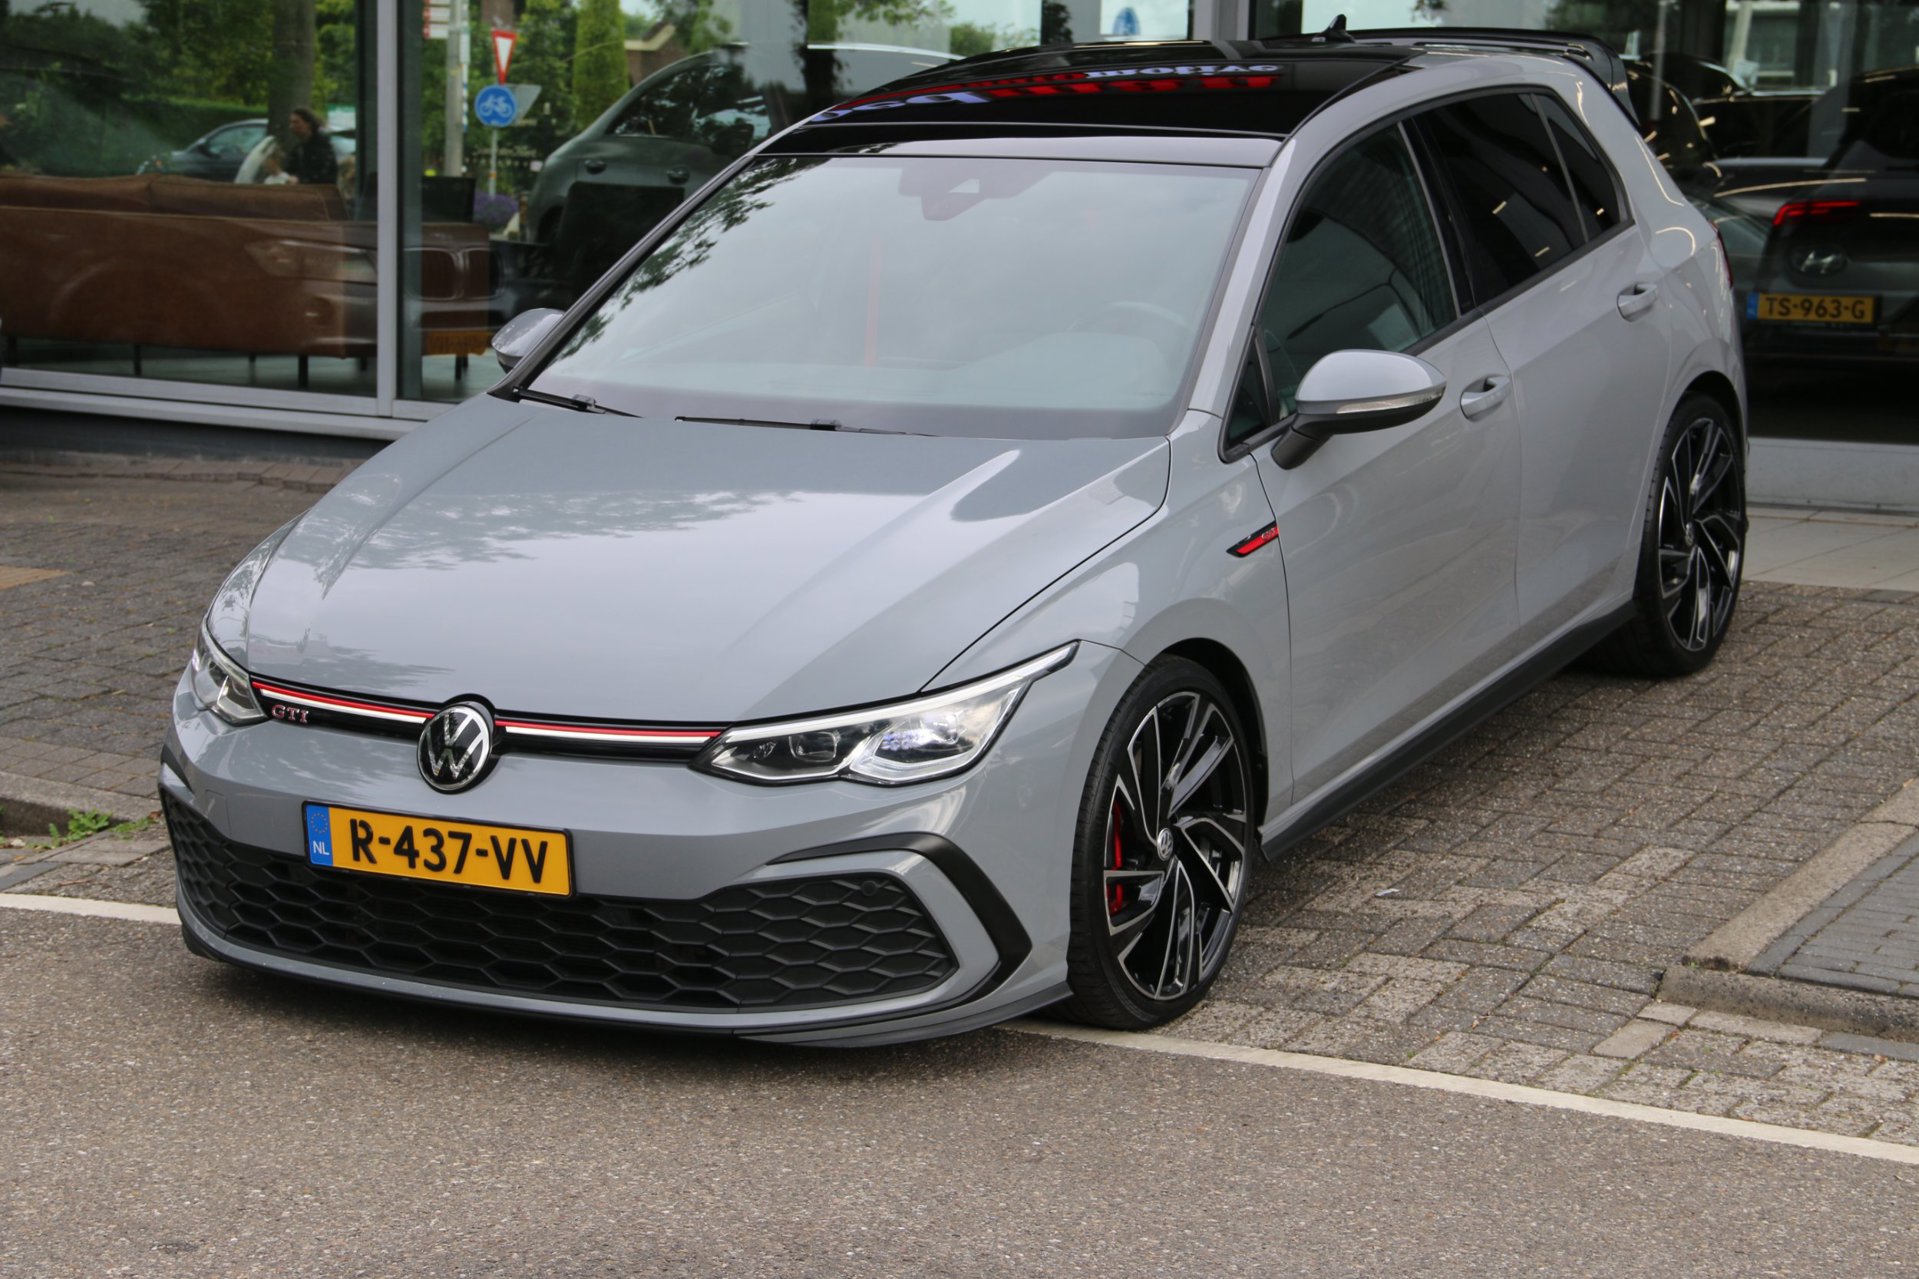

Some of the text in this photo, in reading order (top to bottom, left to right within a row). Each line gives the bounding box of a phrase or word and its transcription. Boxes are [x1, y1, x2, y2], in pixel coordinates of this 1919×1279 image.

[1764, 298, 1866, 320] TS-963-G
[271, 704, 309, 723] GTI
[312, 840, 330, 856] NL
[350, 818, 548, 884] R-437-VV
